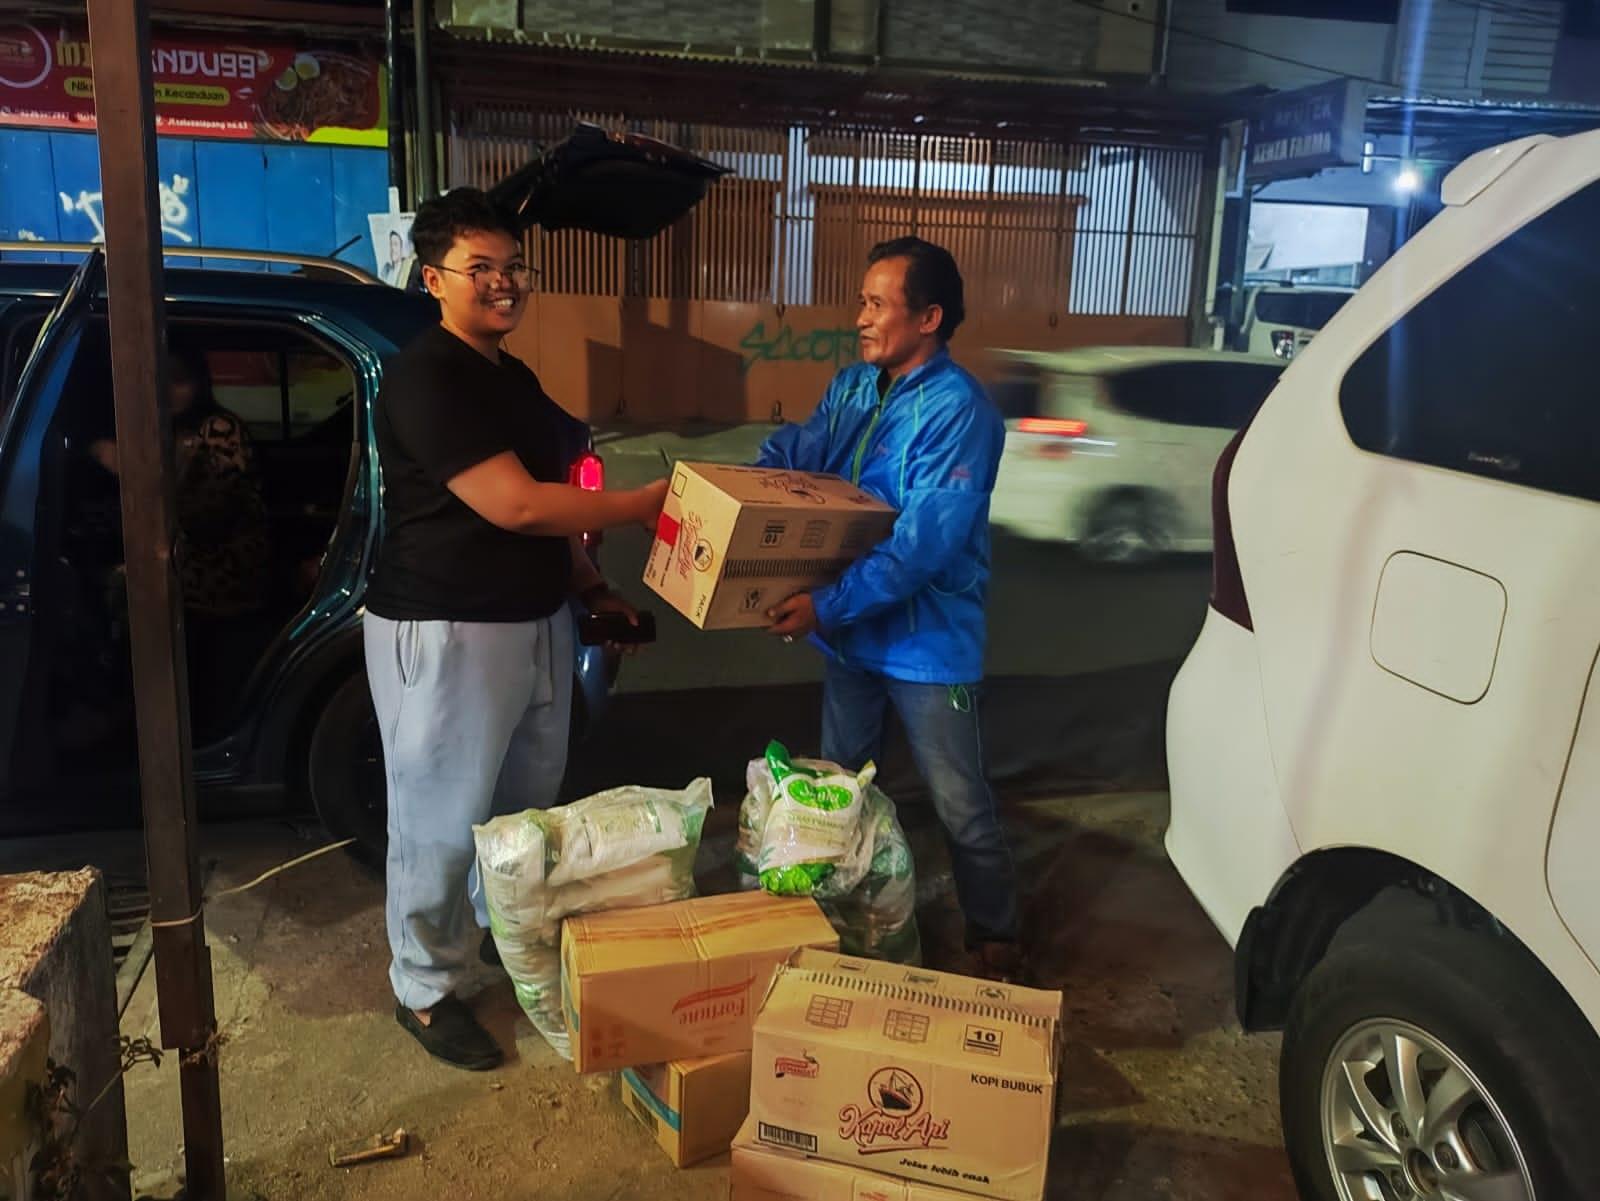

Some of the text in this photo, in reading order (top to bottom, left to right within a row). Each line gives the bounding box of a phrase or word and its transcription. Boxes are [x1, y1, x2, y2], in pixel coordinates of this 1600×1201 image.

[974, 1030, 996, 1042] 10
[971, 1073, 1043, 1095] KOPI BUBUK
[839, 1104, 950, 1147] Kapal Api
[899, 1158, 990, 1185] Jelas lebih enak
